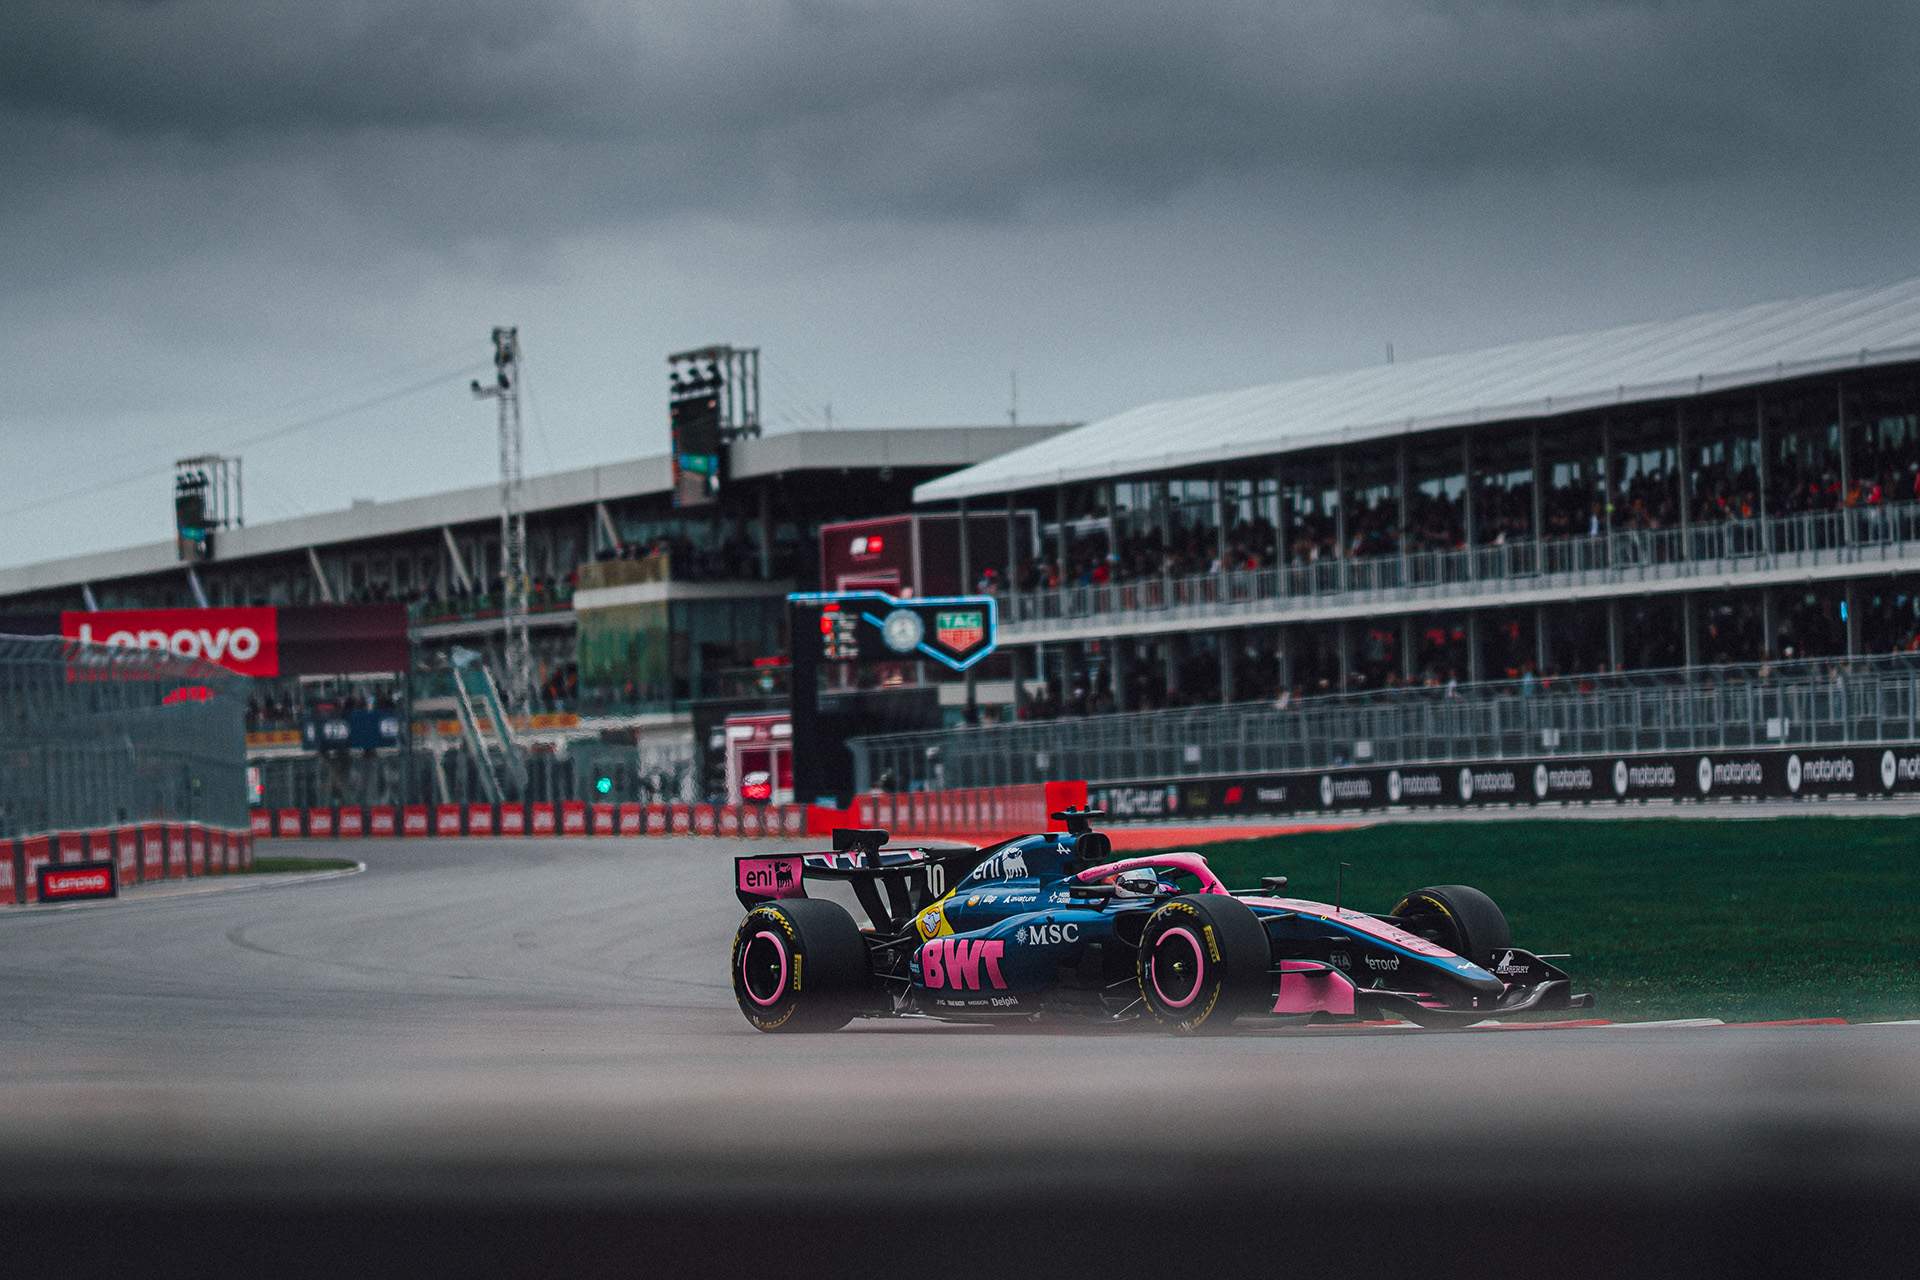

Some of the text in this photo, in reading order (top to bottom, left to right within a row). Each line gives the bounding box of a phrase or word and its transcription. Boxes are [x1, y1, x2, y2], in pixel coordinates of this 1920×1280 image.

[79, 623, 260, 662] Lenovo
[1550, 768, 1593, 789] motorola
[1629, 764, 1675, 786] motorola
[1713, 761, 1763, 784] motorola
[1803, 757, 1855, 781] motorola
[746, 865, 772, 887] eni
[973, 855, 1001, 880] eni
[926, 864, 945, 899] 10
[1029, 923, 1079, 945] MSC
[922, 938, 1008, 990] BWT
[1331, 954, 1350, 968] FIA
[991, 996, 1019, 1008] Delphi
